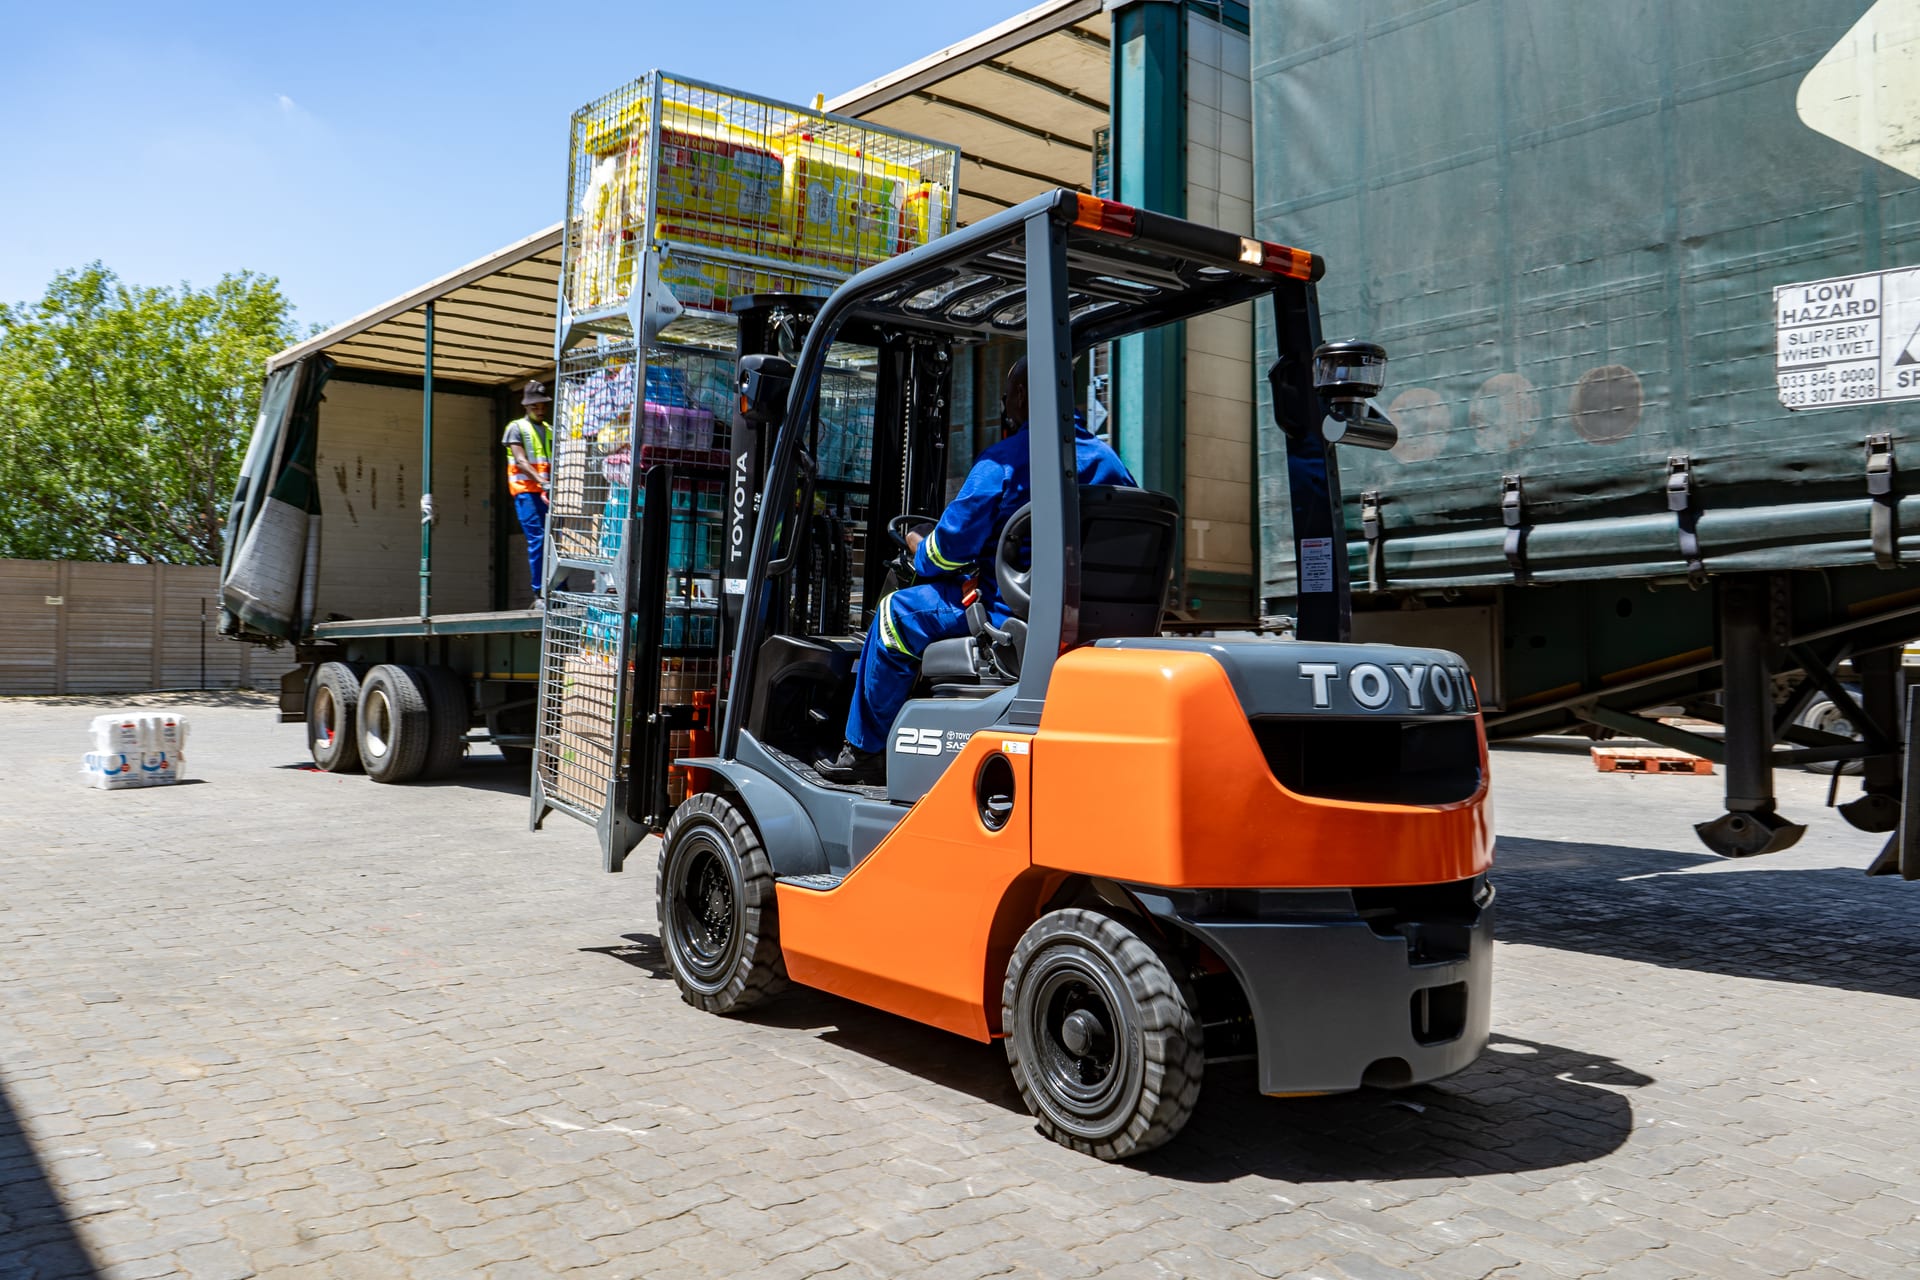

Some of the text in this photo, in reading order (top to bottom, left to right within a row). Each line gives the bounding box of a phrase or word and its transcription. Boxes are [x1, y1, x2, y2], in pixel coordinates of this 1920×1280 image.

[1805, 283, 1855, 303] LOW
[1782, 299, 1876, 324] HAZARD
[1789, 324, 1869, 345] SLIPPERY
[1784, 340, 1875, 361] WHEN WET
[1782, 375, 1805, 389] 033
[1840, 368, 1875, 383] 0000
[1811, 388, 1835, 402] 307
[1841, 384, 1875, 399] 4508
[731, 452, 748, 562] TOYOTA
[895, 728, 943, 756] 25
[955, 732, 972, 740] TOYO
